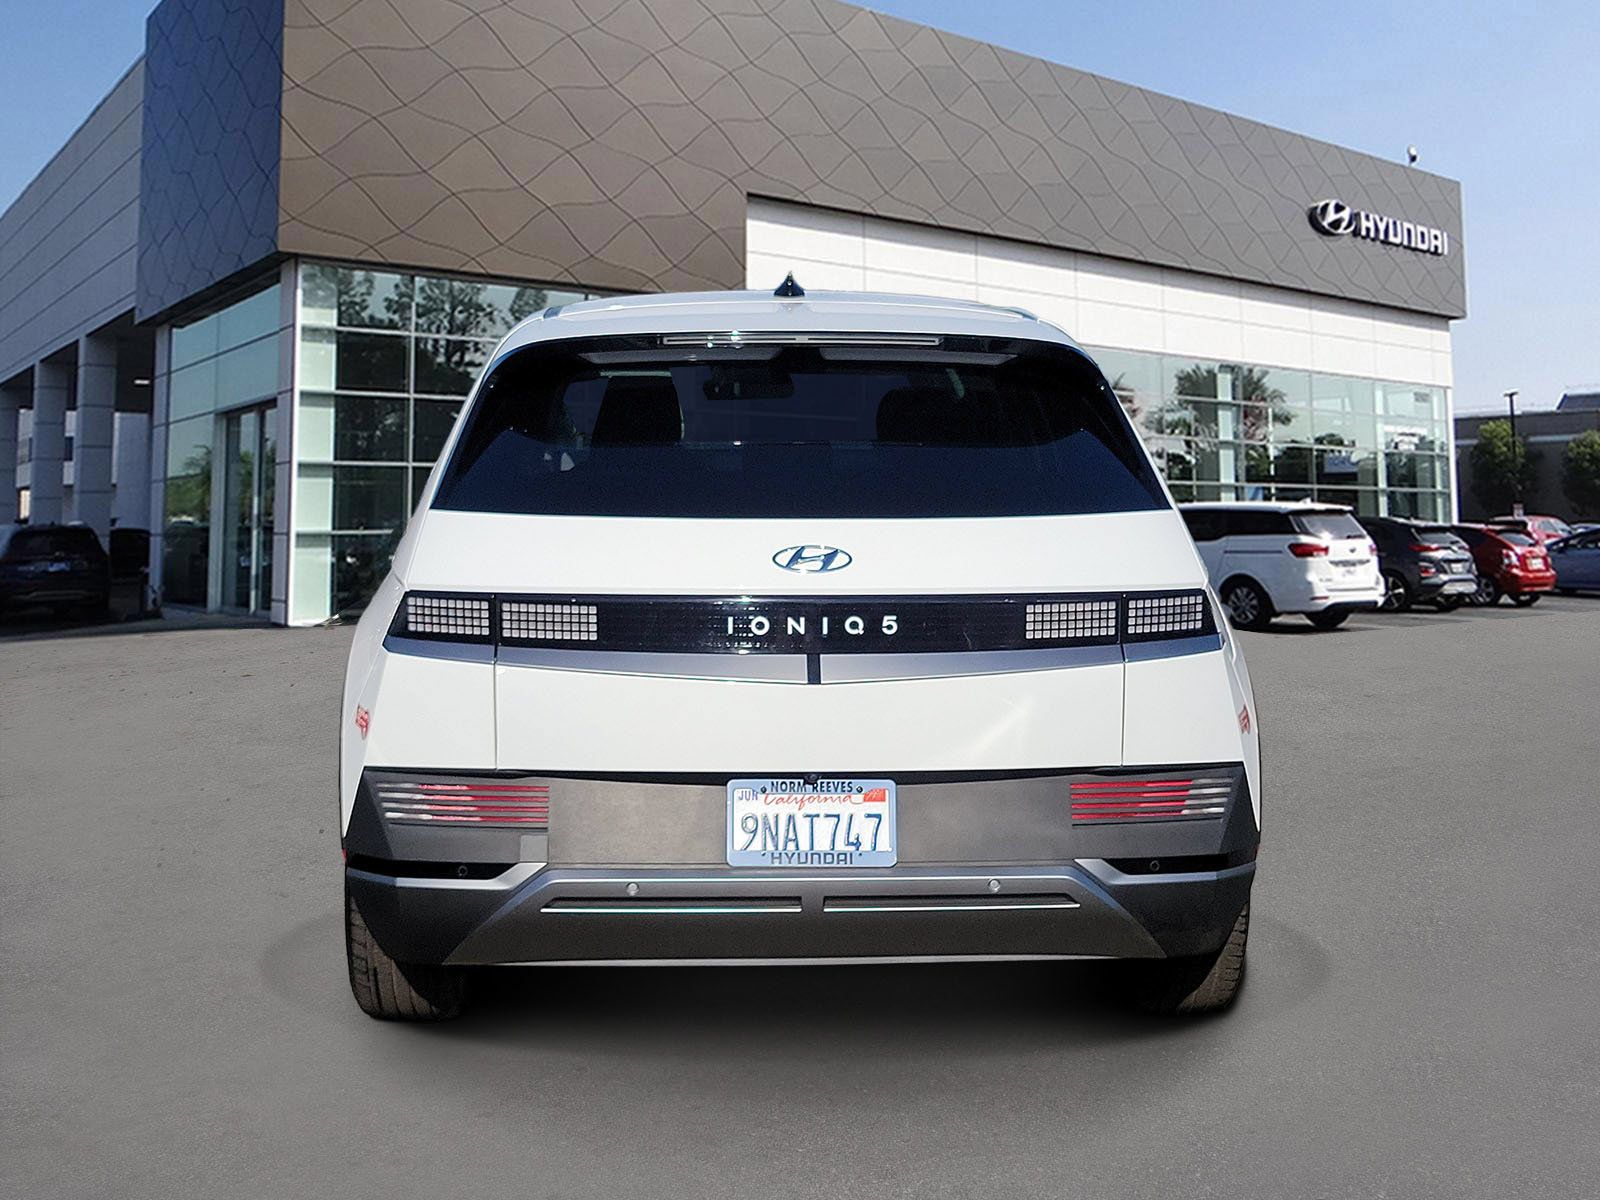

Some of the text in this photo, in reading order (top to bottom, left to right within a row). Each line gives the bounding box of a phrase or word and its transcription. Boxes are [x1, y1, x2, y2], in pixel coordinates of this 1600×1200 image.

[1360, 211, 1448, 255] HYUNDAI
[727, 615, 898, 635] IONIQ 5
[770, 781, 853, 793] NORM REEVES
[763, 793, 863, 811] California
[741, 813, 882, 850] 9NAT747
[771, 852, 853, 865] HYUNDAI
